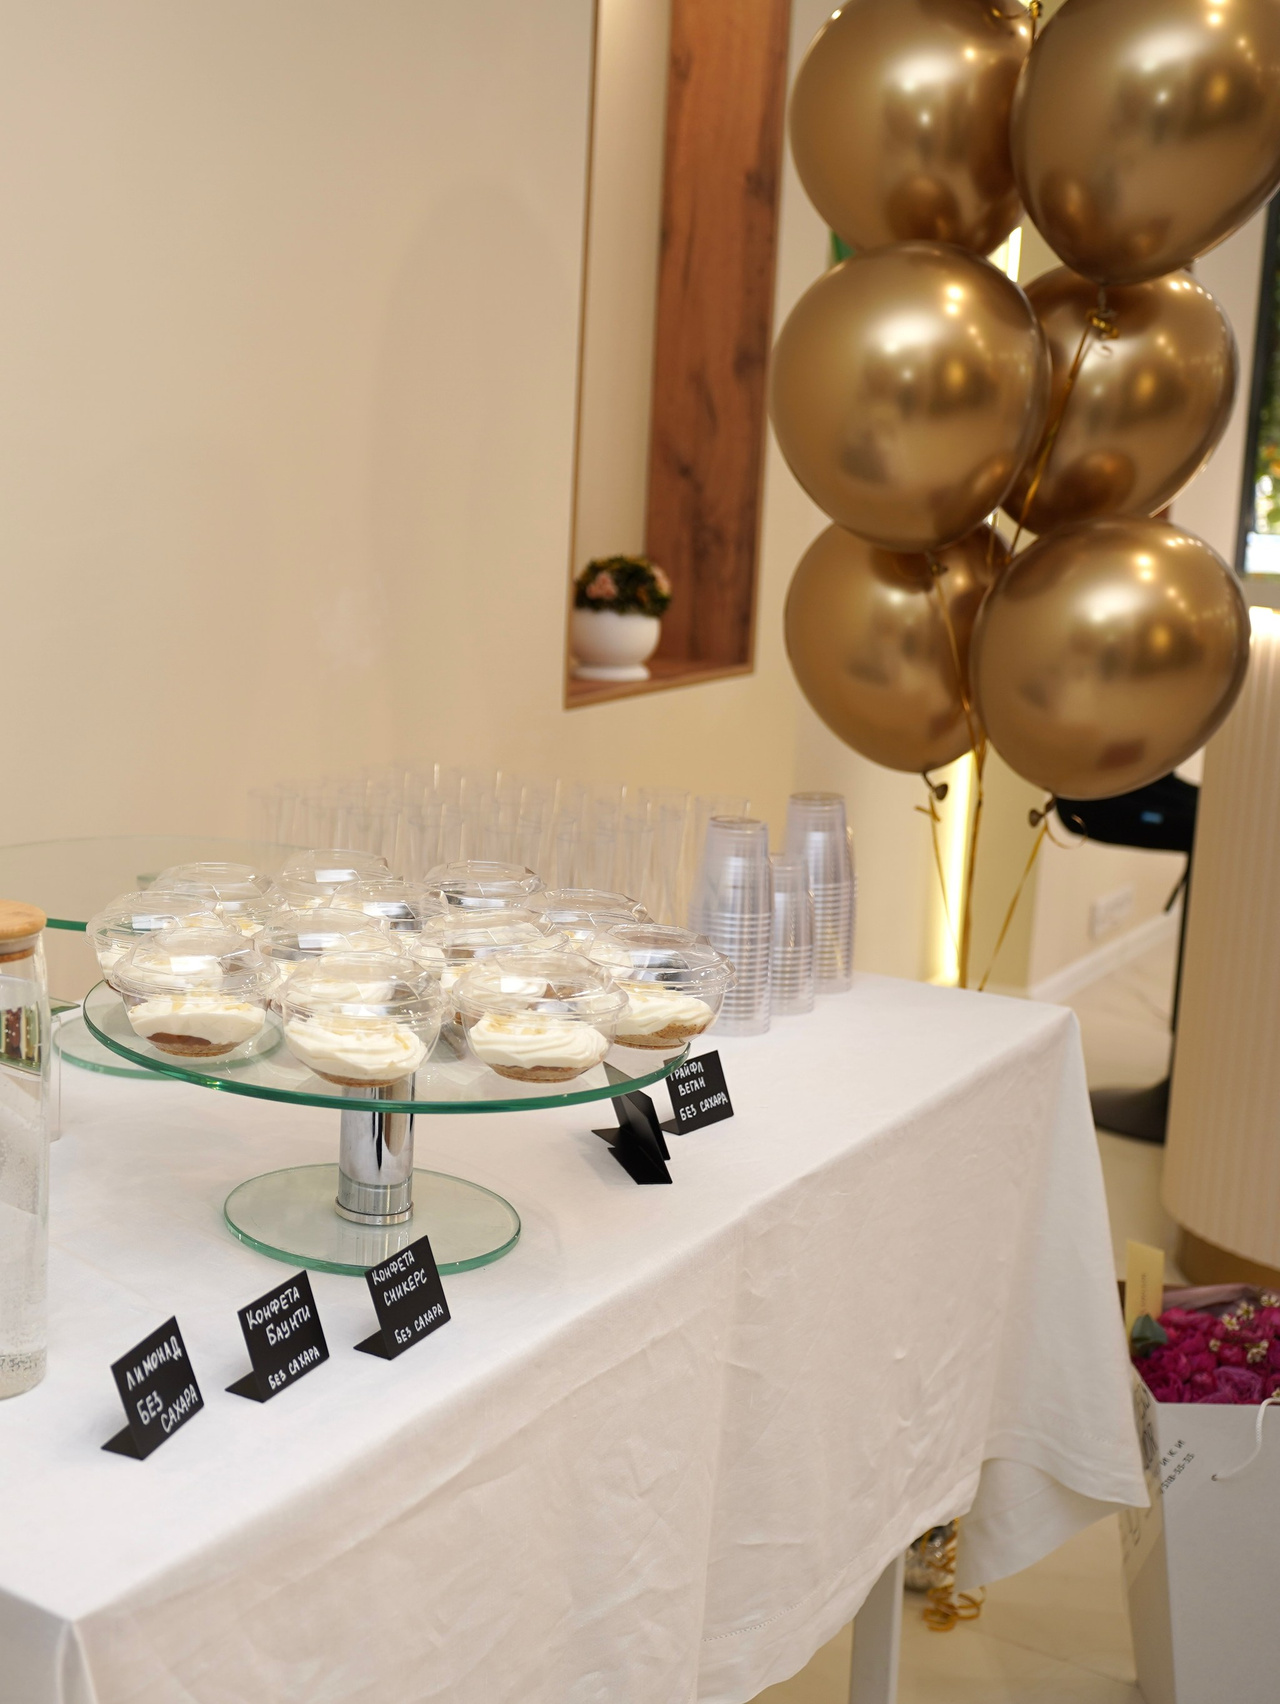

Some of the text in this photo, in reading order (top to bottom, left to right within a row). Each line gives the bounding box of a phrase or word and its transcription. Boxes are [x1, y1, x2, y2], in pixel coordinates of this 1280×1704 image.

[678, 1076, 706, 1097] ВЕГАН
[679, 1091, 728, 1121] БЕЗ САХАРА
[371, 1250, 415, 1286] КОНФЕТА
[383, 1268, 428, 1306] СНИКЕРС
[245, 1286, 300, 1330] КОНФЕТА
[265, 1305, 311, 1346] БАУНТИ
[394, 1303, 444, 1344] БЕЗ САХАРА
[126, 1335, 182, 1391] ЛИМОНАД
[268, 1345, 320, 1390] БЕЗ САХАРА
[136, 1383, 199, 1433] БЕЗ САХАРА
